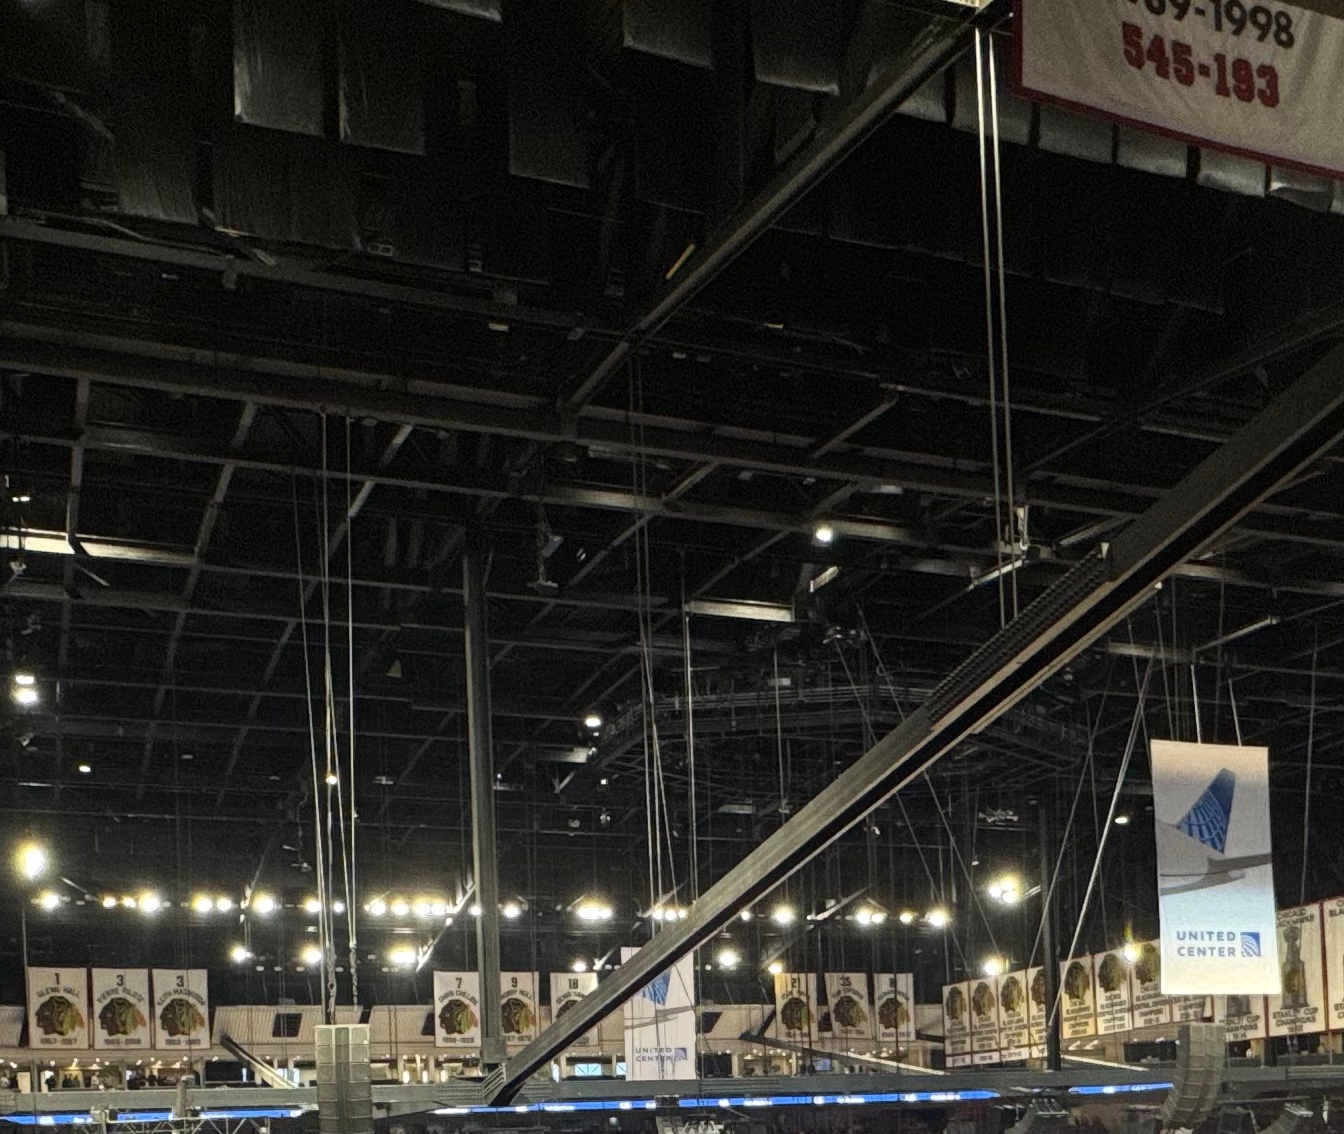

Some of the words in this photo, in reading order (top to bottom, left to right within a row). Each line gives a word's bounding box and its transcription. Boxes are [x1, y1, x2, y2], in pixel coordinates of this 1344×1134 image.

[1122, 21, 1280, 108] 545-193
[1176, 931, 1236, 942] UNITED
[1177, 946, 1236, 958] CENTER
[116, 974, 124, 987] 3
[176, 975, 184, 988] 3
[455, 977, 463, 989] 7
[511, 976, 518, 989] 9
